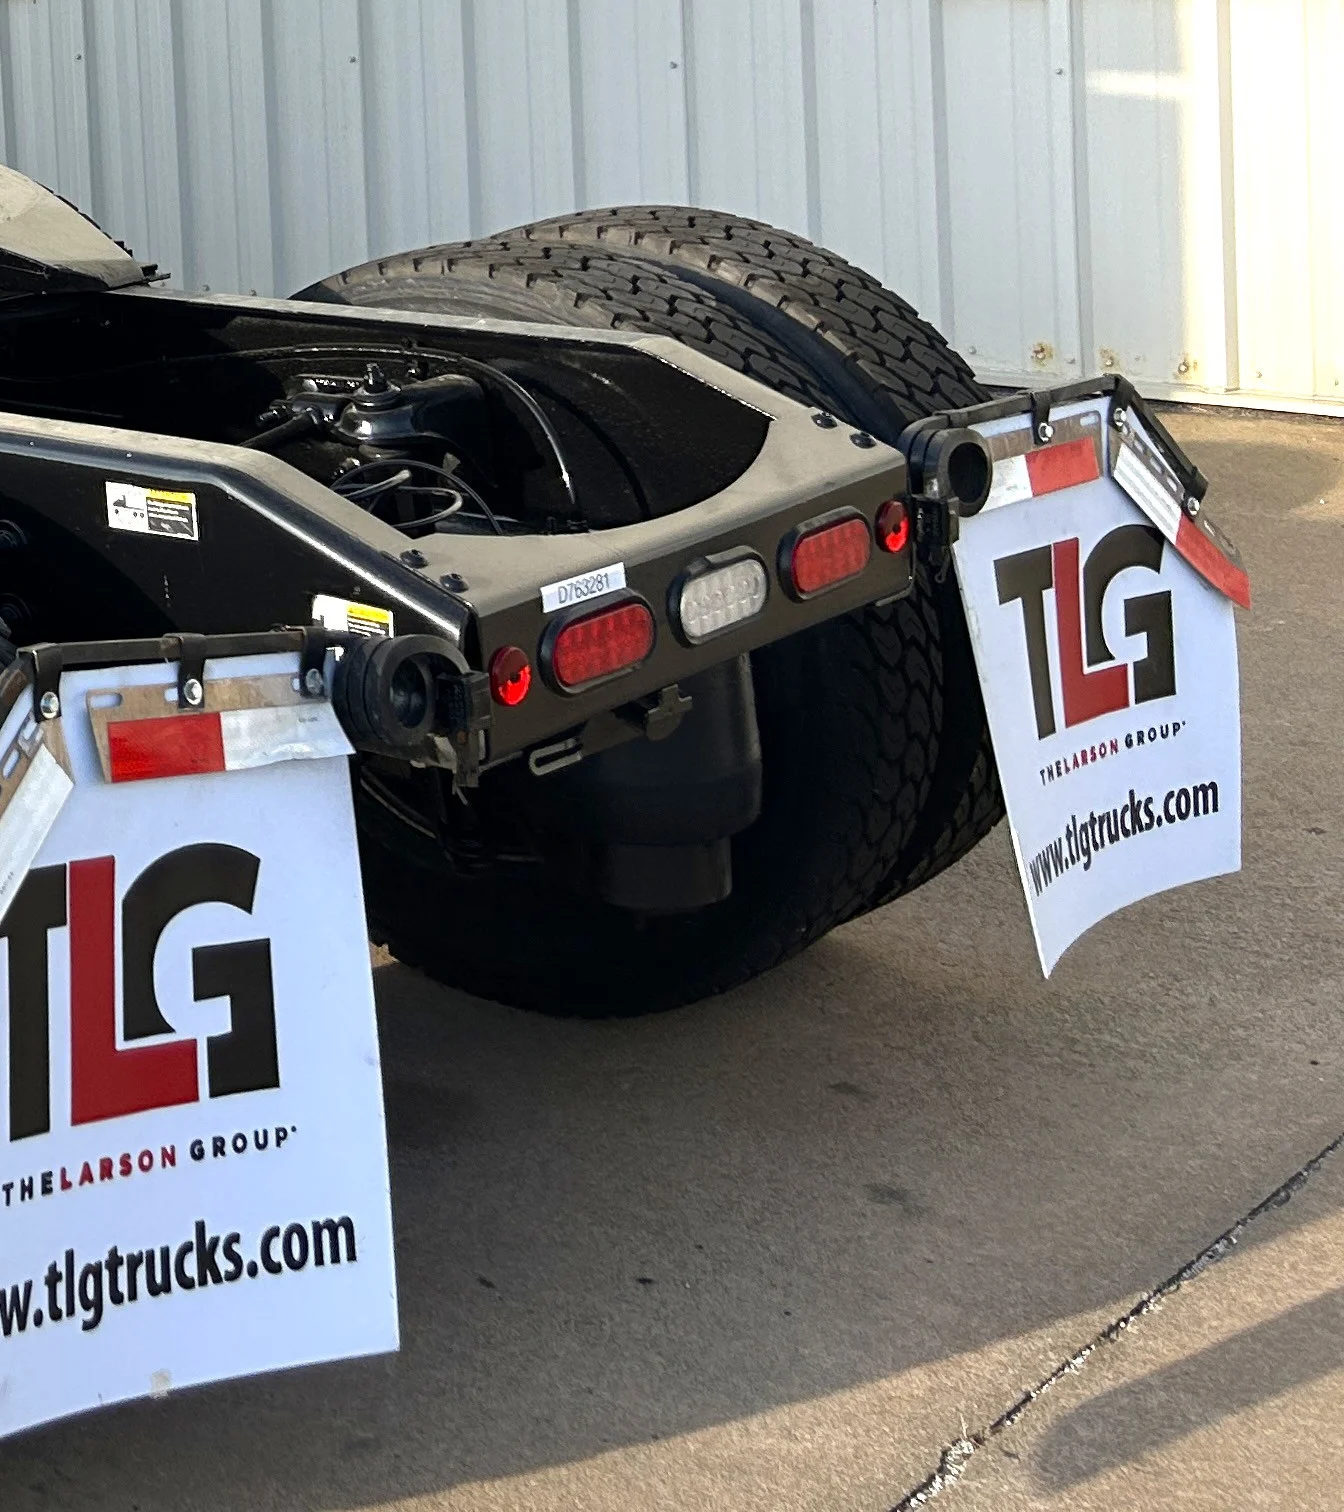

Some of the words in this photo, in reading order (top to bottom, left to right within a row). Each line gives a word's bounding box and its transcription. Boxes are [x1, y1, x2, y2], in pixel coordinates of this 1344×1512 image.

[557, 572, 610, 604] D763281
[993, 524, 1177, 741] TLG
[1030, 777, 1220, 897] www.tlgtrucks.com
